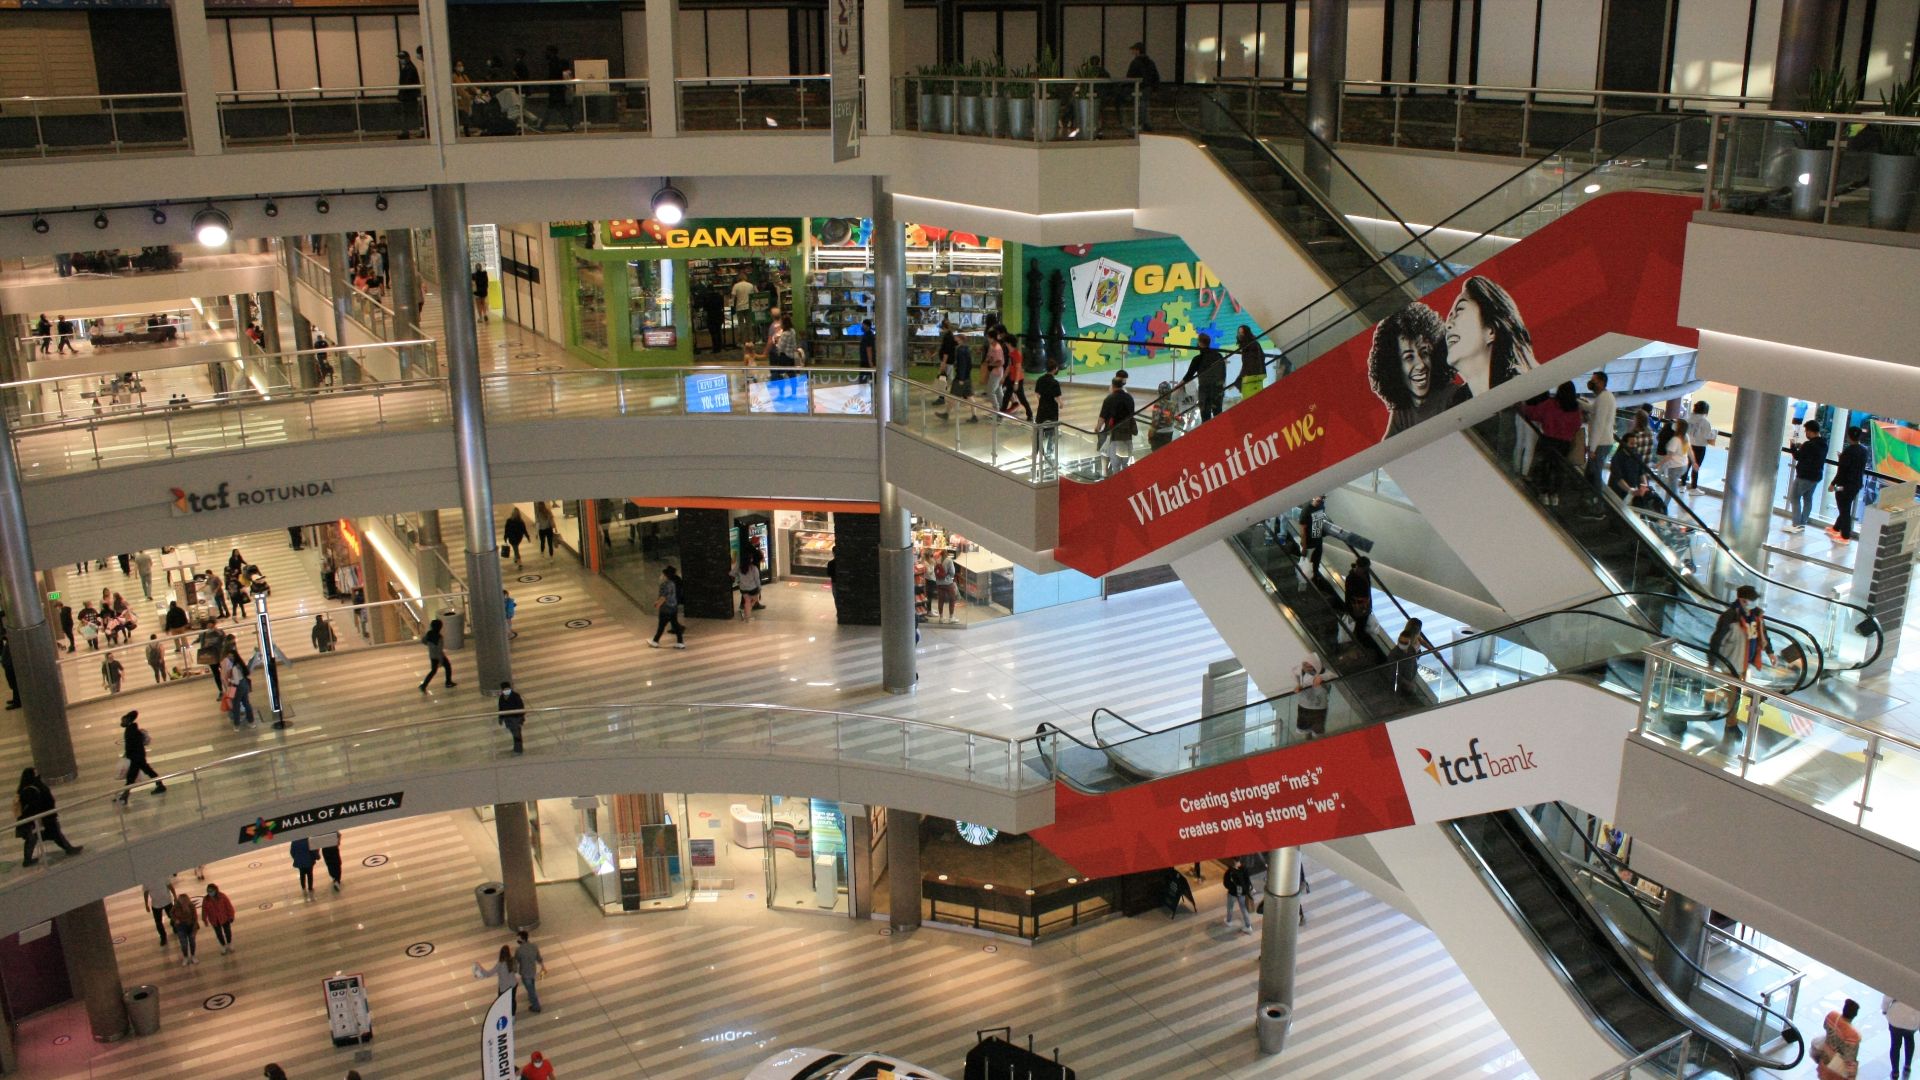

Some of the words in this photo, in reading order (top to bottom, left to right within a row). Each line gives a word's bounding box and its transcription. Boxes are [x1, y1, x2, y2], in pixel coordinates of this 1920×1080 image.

[834, 103, 852, 118] LEVEL
[846, 103, 860, 157] 4
[665, 227, 794, 248] GAMES
[1199, 265, 1226, 320] by
[1128, 468, 1203, 526] What's
[1200, 461, 1229, 493] in
[1224, 448, 1247, 481] it
[1243, 432, 1281, 472] for
[1281, 413, 1324, 451] we.
[187, 482, 230, 513] tcf
[237, 482, 333, 506] ROTUNDA
[282, 813, 314, 829] MALL
[318, 808, 335, 820] OF
[339, 797, 396, 816] AMERICA
[1180, 791, 1229, 813] Creating
[1230, 781, 1281, 804] stronger
[1179, 821, 1220, 839] creates
[1220, 816, 1243, 832] one
[1243, 809, 1265, 829] big
[1265, 803, 1307, 821] strong
[497, 1033, 511, 1078] MARCH
